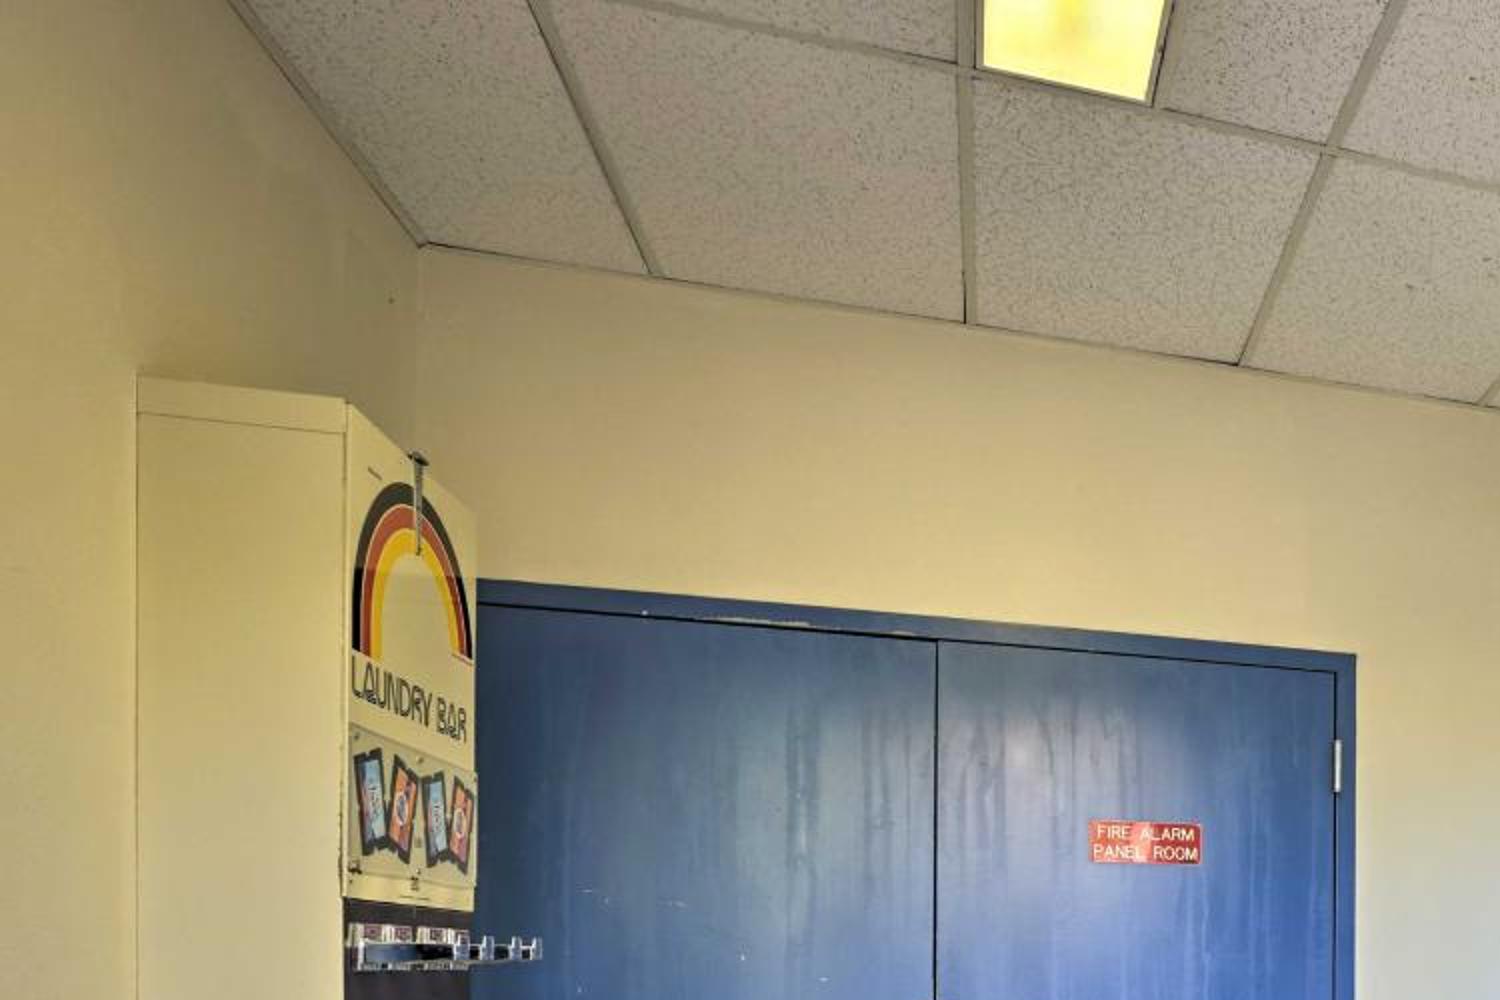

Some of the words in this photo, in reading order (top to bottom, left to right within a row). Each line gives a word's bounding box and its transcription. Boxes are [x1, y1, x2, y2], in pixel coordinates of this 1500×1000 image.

[351, 654, 433, 728] LAUNDRY
[436, 696, 467, 744] BAR
[1097, 824, 1131, 839] FIRE
[1139, 828, 1195, 841] ALARM
[1093, 843, 1145, 859] PANEL
[1153, 845, 1199, 860] ROOM
